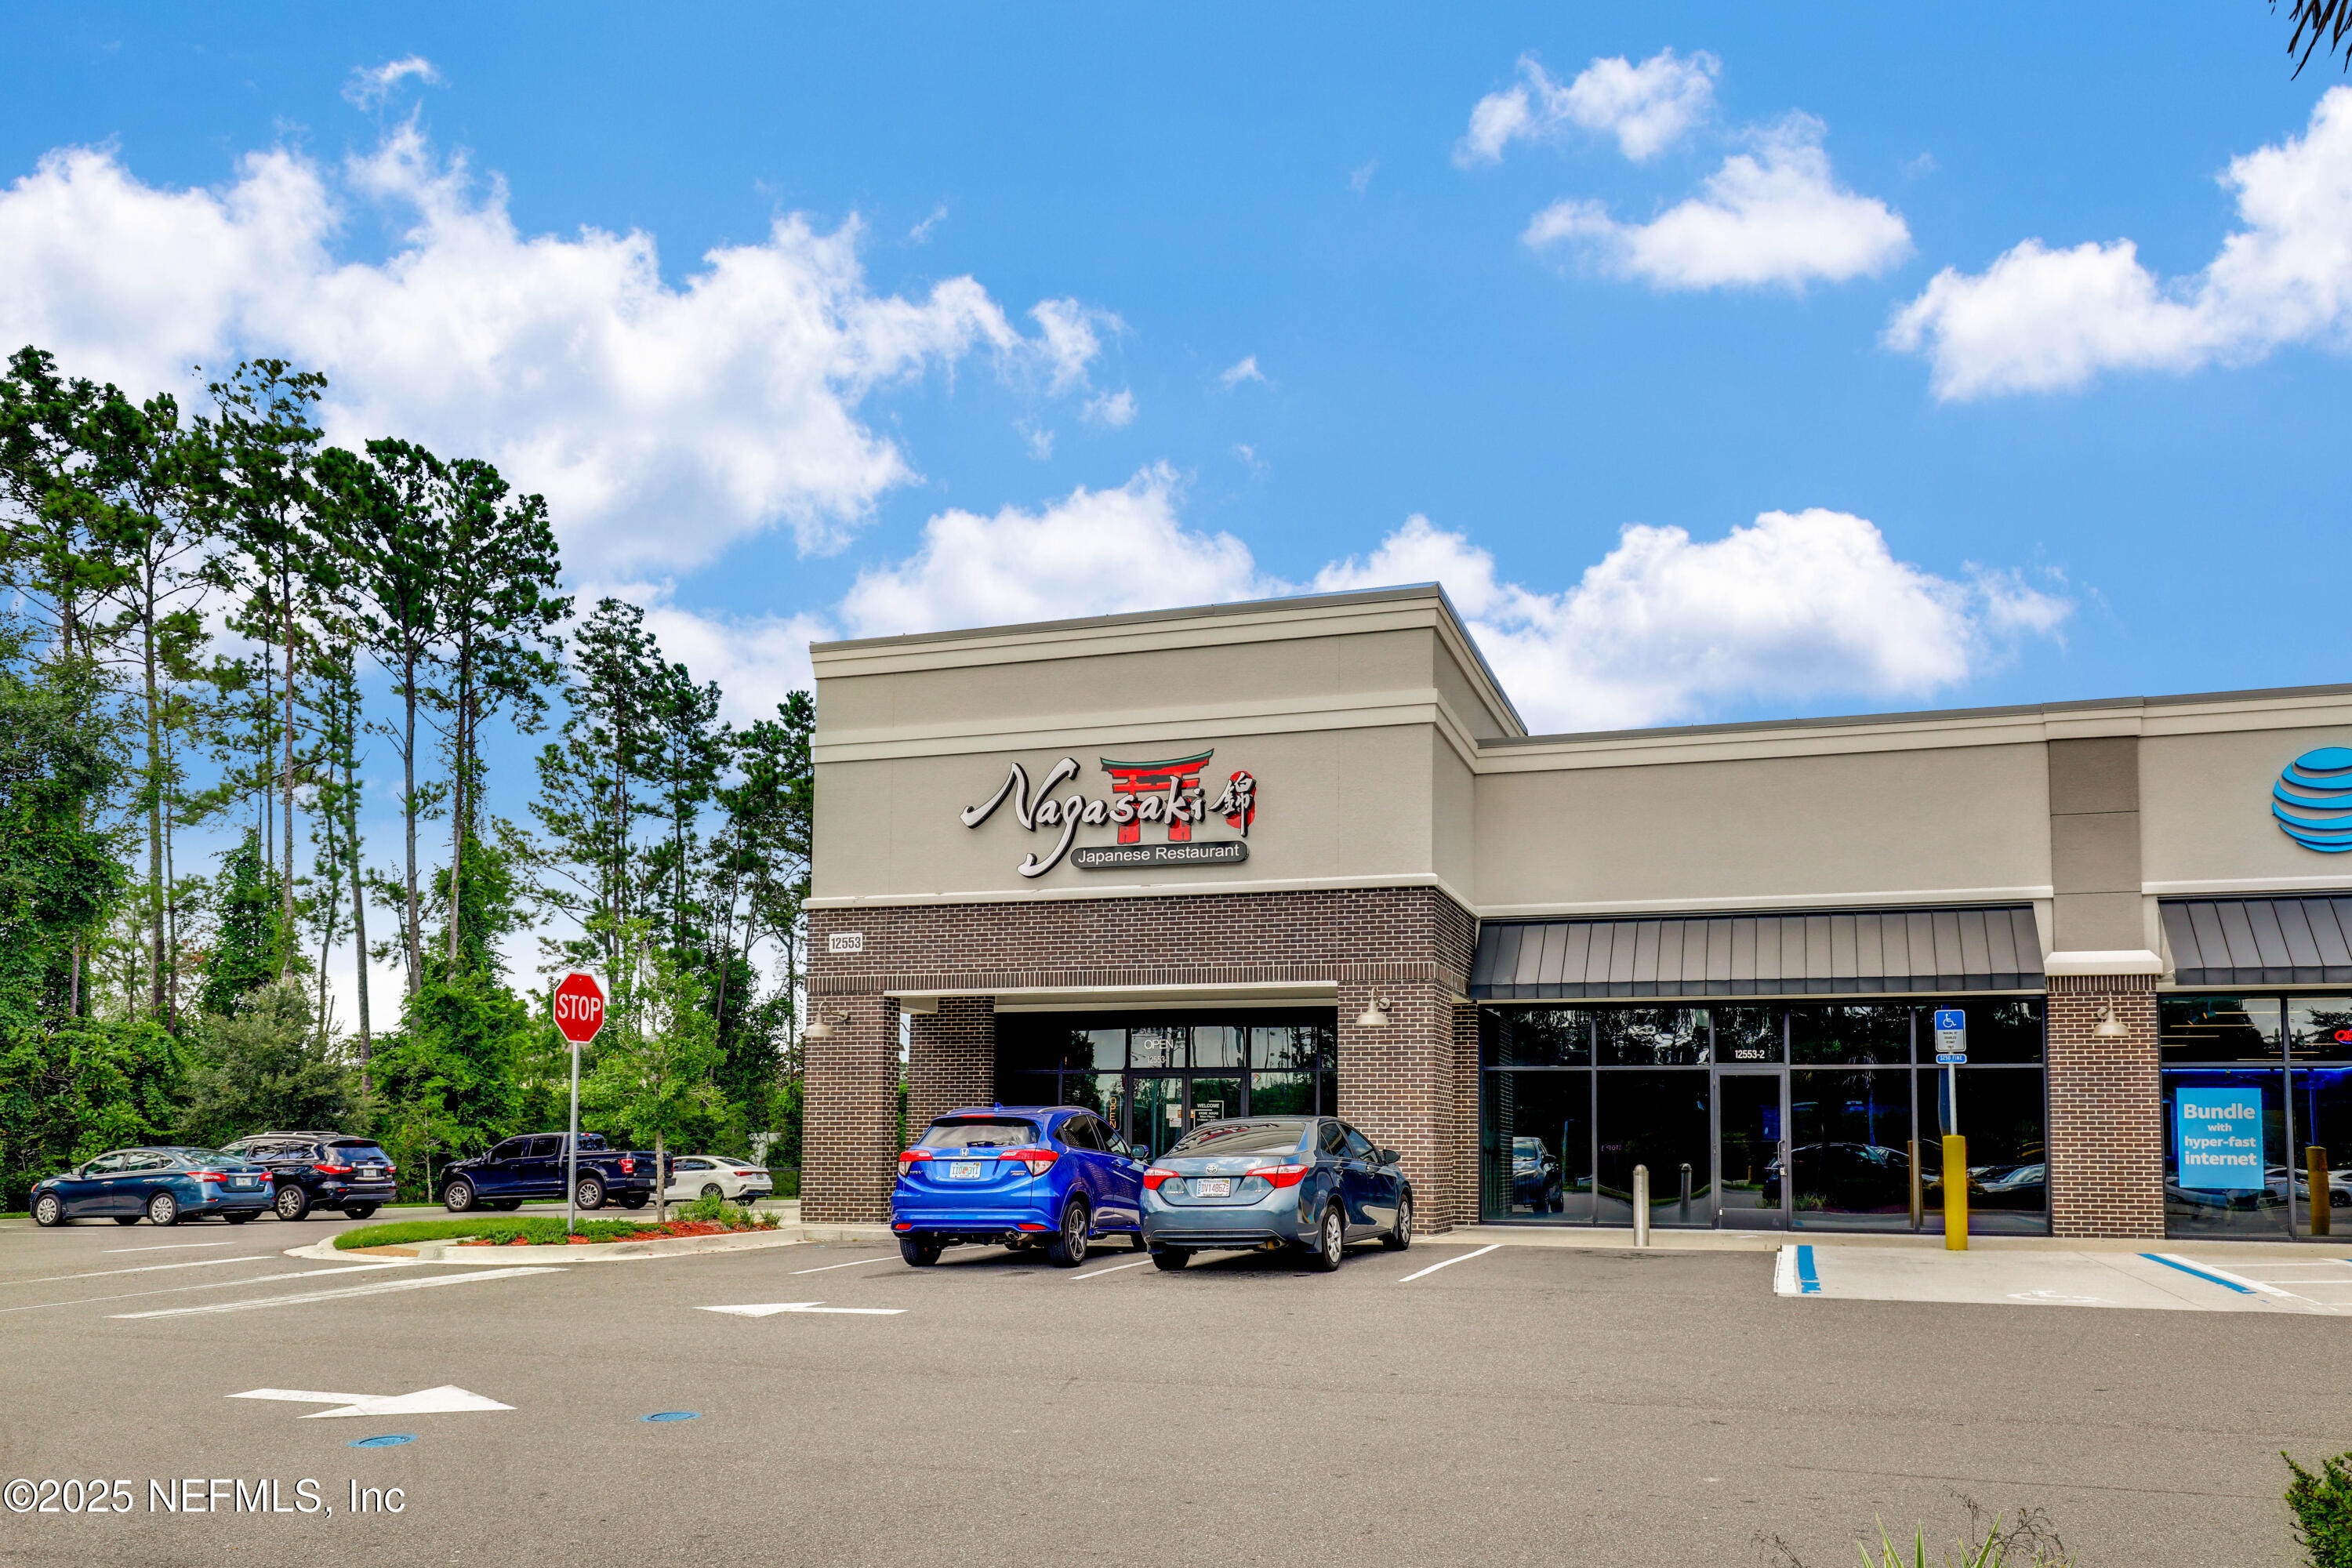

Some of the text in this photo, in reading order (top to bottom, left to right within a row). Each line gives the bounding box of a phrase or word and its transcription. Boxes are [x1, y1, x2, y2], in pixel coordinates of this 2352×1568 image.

[960, 757, 1205, 879] Nagasaki
[1077, 844, 1240, 865] Japanese Restaurant
[831, 936, 861, 949] 12553
[557, 993, 601, 1022] STOP
[1144, 1039, 1174, 1050] OPEN
[1734, 1049, 1766, 1059] 12553-2
[2183, 1102, 2256, 1120] Bundle
[2207, 1123, 2233, 1132] with
[2184, 1135, 2256, 1149] hyper-fast
[2184, 1150, 2258, 1166] internet
